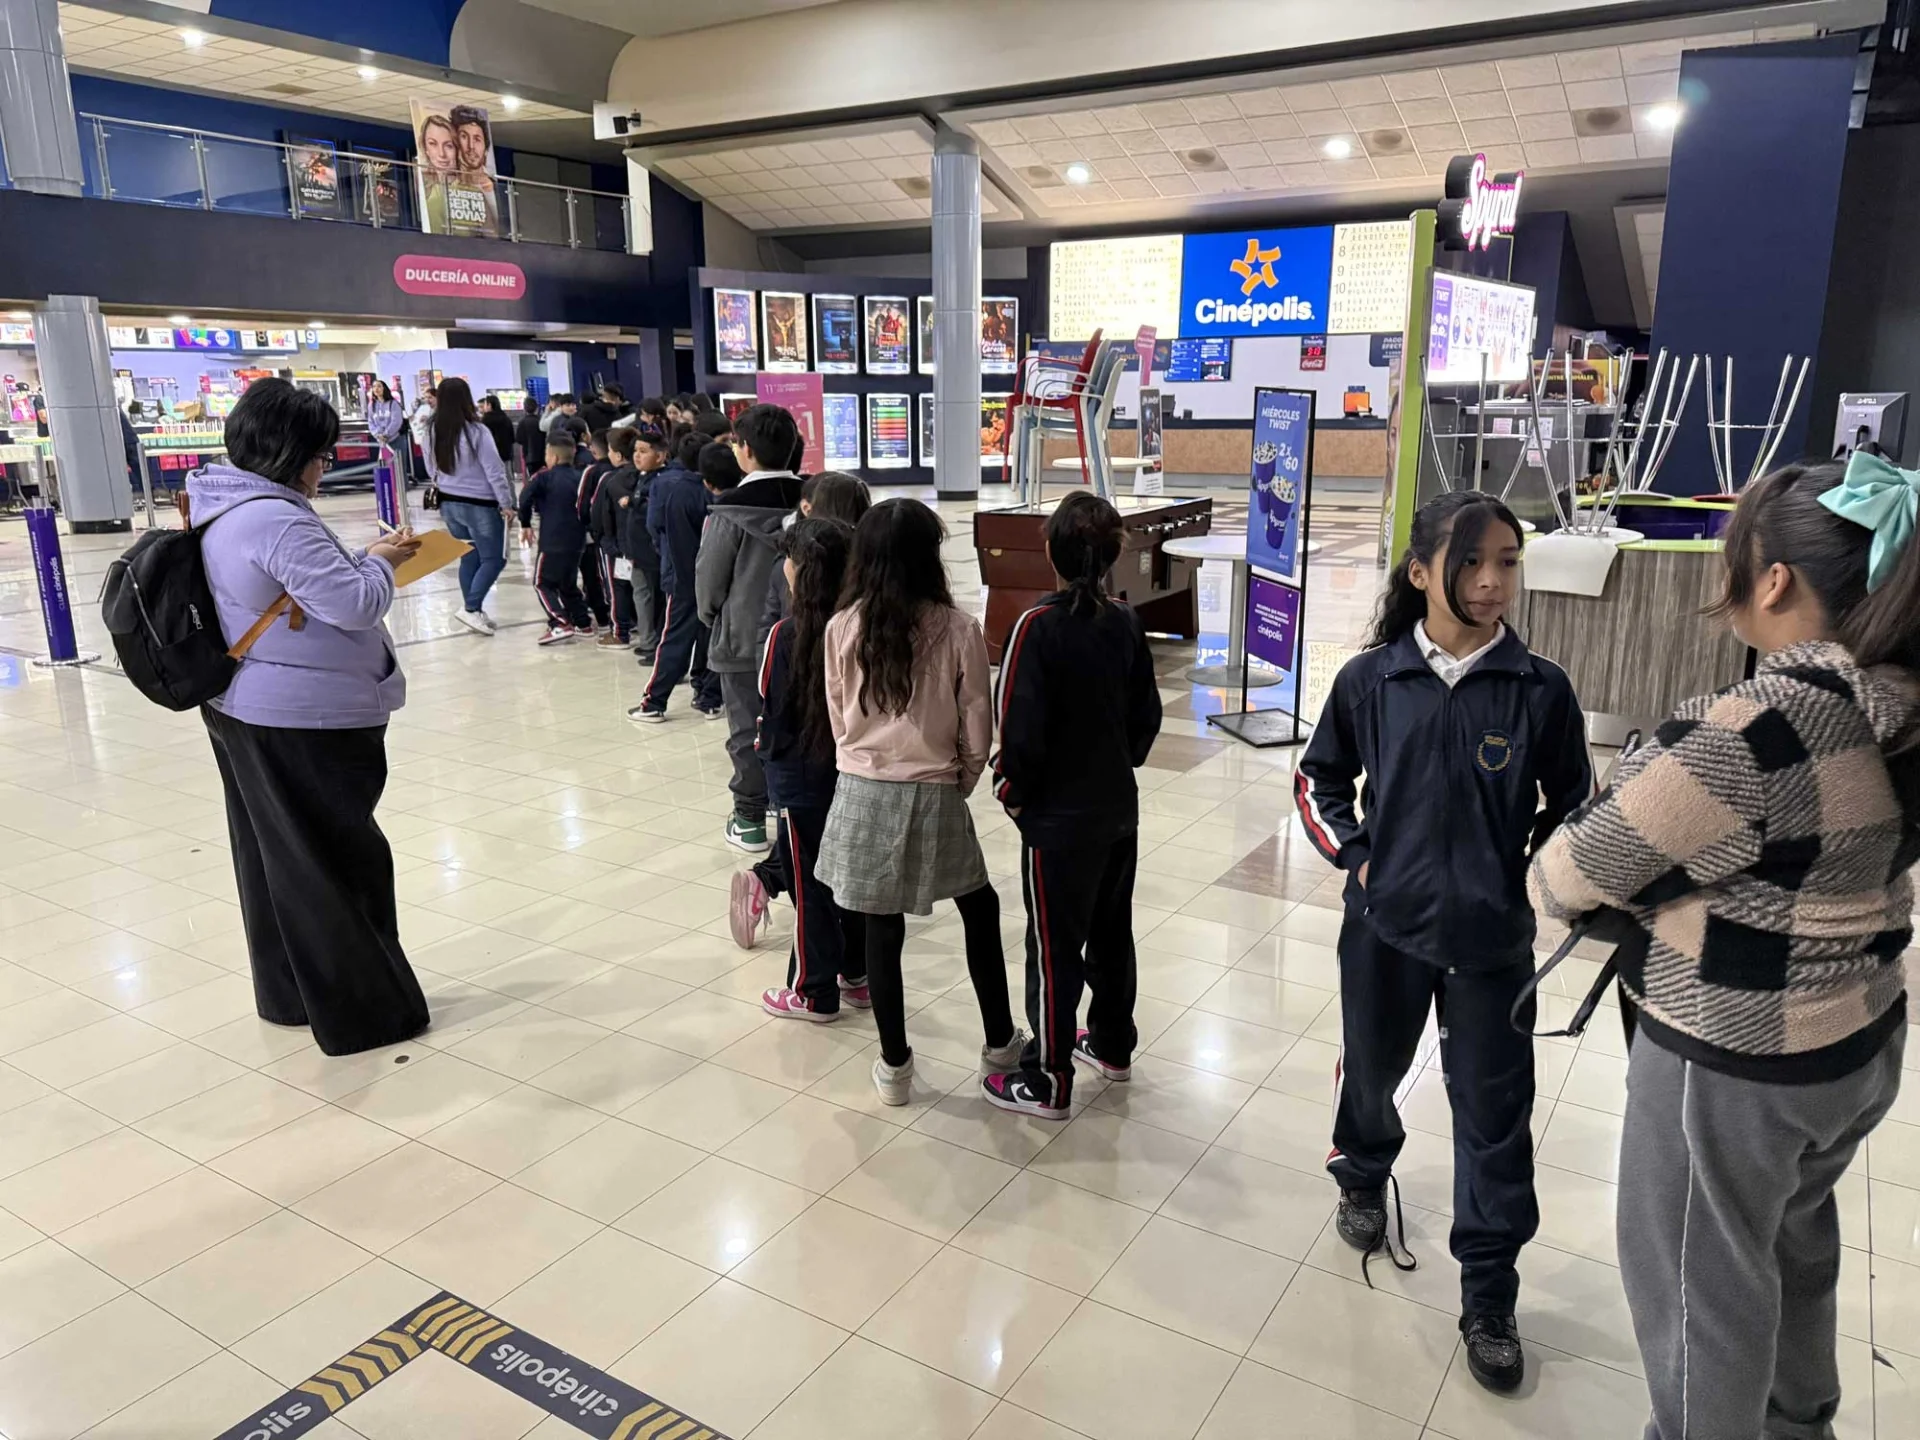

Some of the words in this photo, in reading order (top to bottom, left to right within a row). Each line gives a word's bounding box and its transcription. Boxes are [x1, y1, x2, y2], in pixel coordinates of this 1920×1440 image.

[405, 268, 469, 284] DULCERÍA
[473, 273, 516, 287] ONLINE
[1195, 296, 1315, 327] Cinépolis
[1261, 405, 1300, 421] MIÉRCOLES
[1268, 419, 1291, 430] TWIST
[489, 1343, 621, 1418] cinépolis
